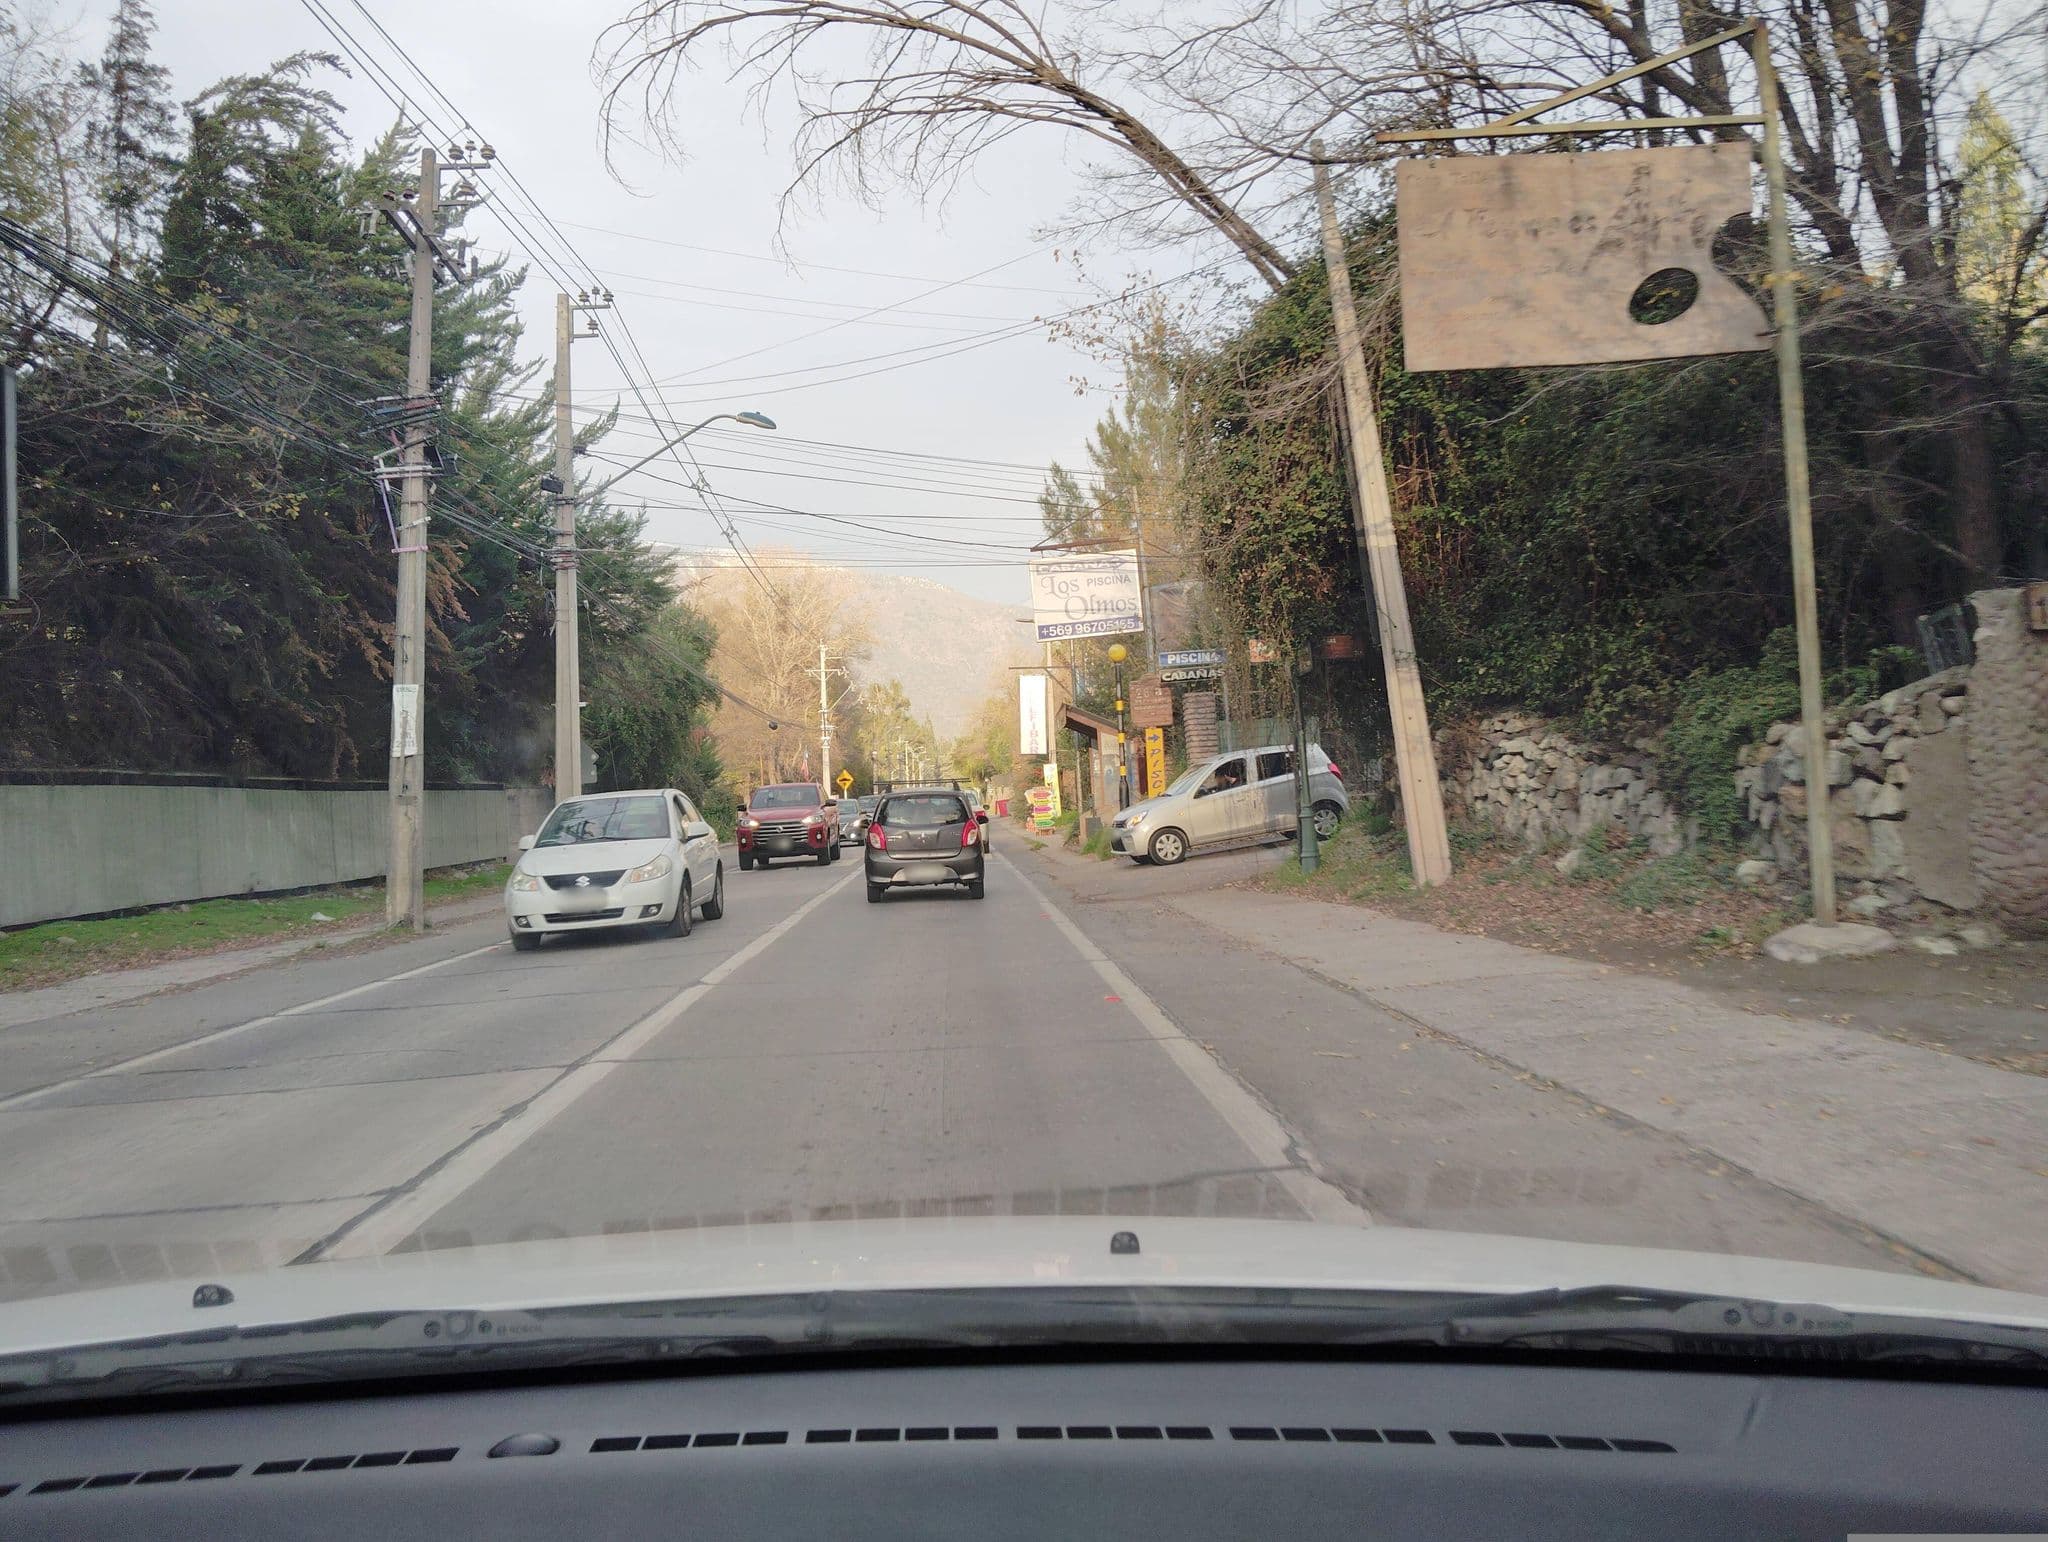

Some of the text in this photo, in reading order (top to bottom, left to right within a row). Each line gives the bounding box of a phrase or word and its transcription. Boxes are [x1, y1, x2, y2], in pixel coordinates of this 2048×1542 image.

[1041, 575, 1080, 600] Los
[1087, 575, 1131, 587] PISCINA
[1065, 594, 1137, 621] Olmos
[1041, 625, 1073, 637] +569
